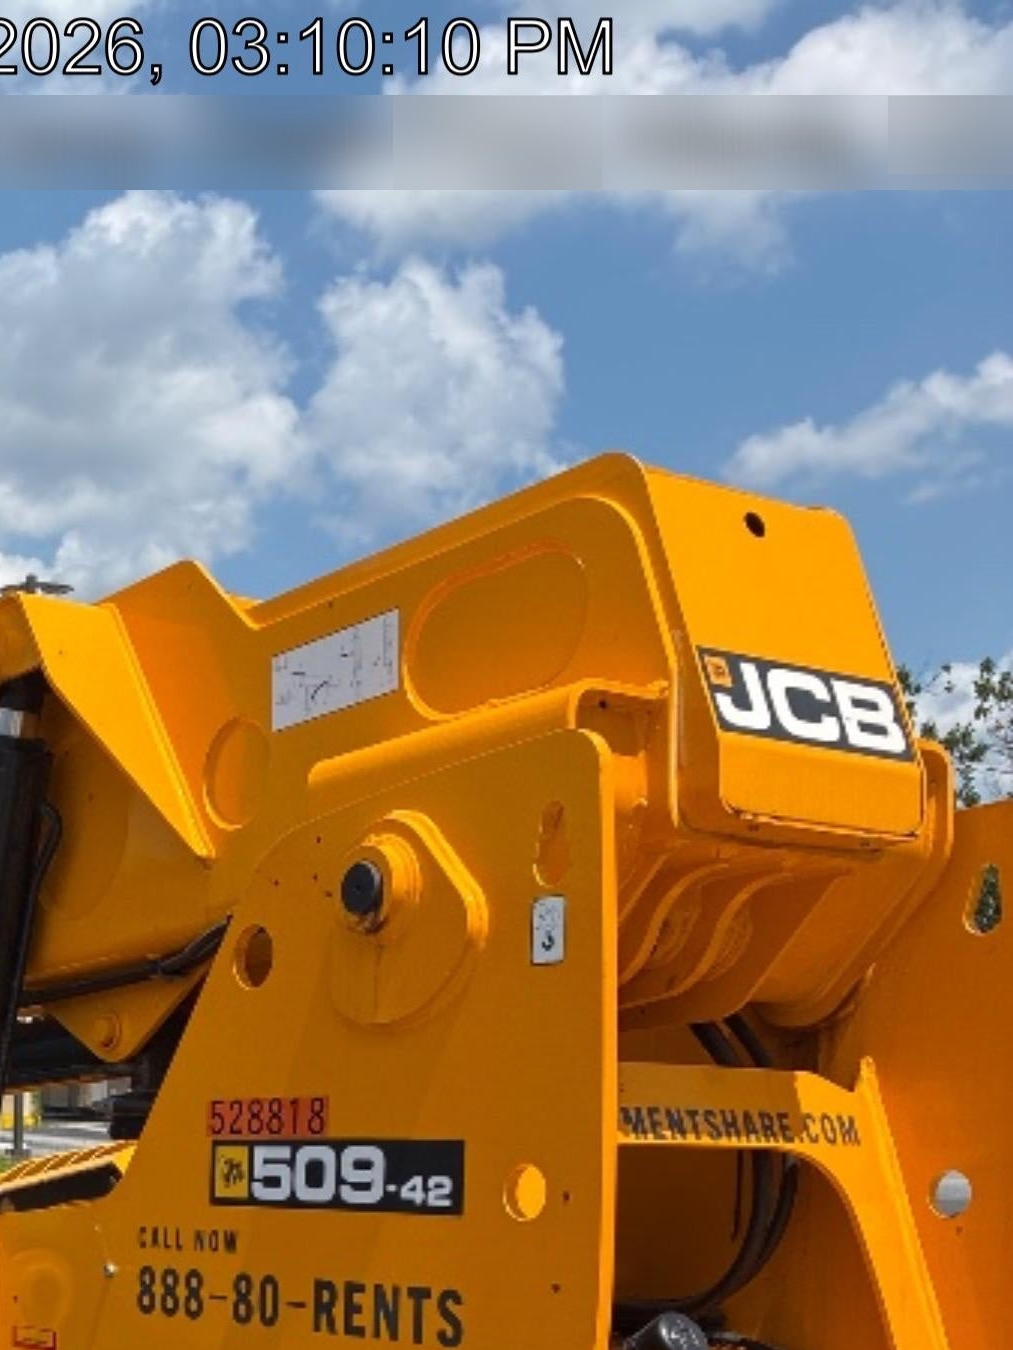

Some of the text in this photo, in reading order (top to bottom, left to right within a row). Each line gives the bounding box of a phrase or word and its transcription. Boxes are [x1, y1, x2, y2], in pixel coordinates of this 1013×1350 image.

[714, 661, 908, 754] JCB
[210, 1097, 326, 1136] 528818
[250, 1145, 454, 1208] 509-42
[139, 1226, 238, 1255] CALL NOW
[137, 1265, 465, 1349] 888-80-RENTS
